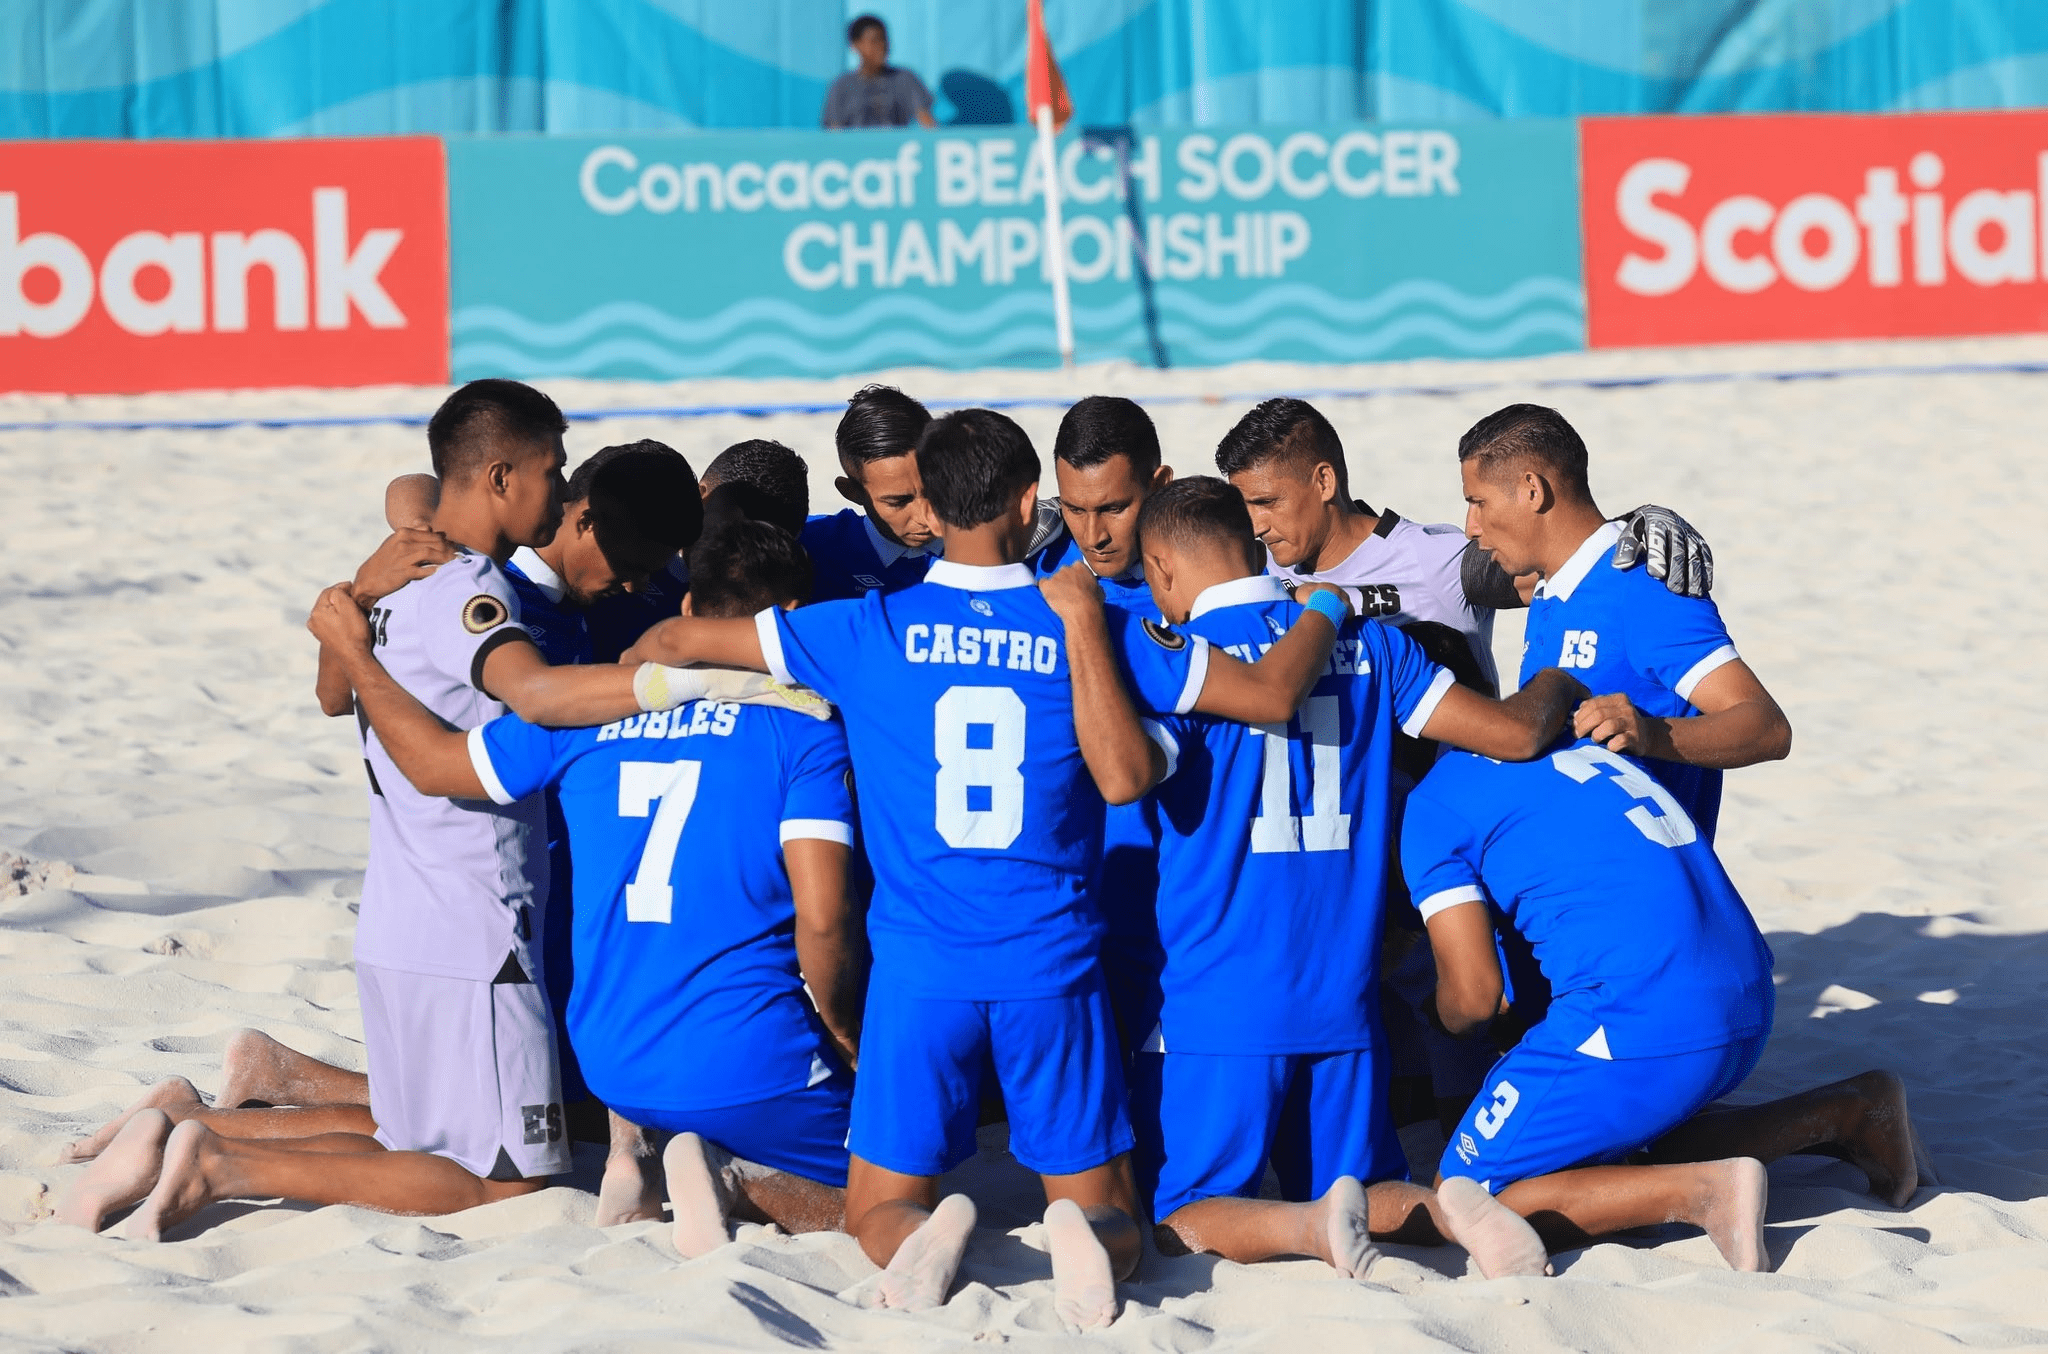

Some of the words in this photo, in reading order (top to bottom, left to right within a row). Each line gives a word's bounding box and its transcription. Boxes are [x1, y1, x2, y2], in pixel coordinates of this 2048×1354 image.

[580, 141, 921, 214] Concacaf
[935, 137, 1161, 206] BEACH
[1176, 131, 1461, 201] SOCCER
[0, 187, 407, 338] bank
[783, 211, 1310, 290] CHAMPIONSHIP
[1361, 584, 1402, 617] ES
[905, 623, 1057, 675] CASTRO
[1557, 630, 1598, 668] ES
[935, 686, 1026, 849] 8
[1249, 695, 1351, 853] 11
[1552, 745, 1697, 848] 3
[619, 760, 701, 923] 7
[521, 1102, 562, 1145] ES
[1475, 1080, 1520, 1140] 3
